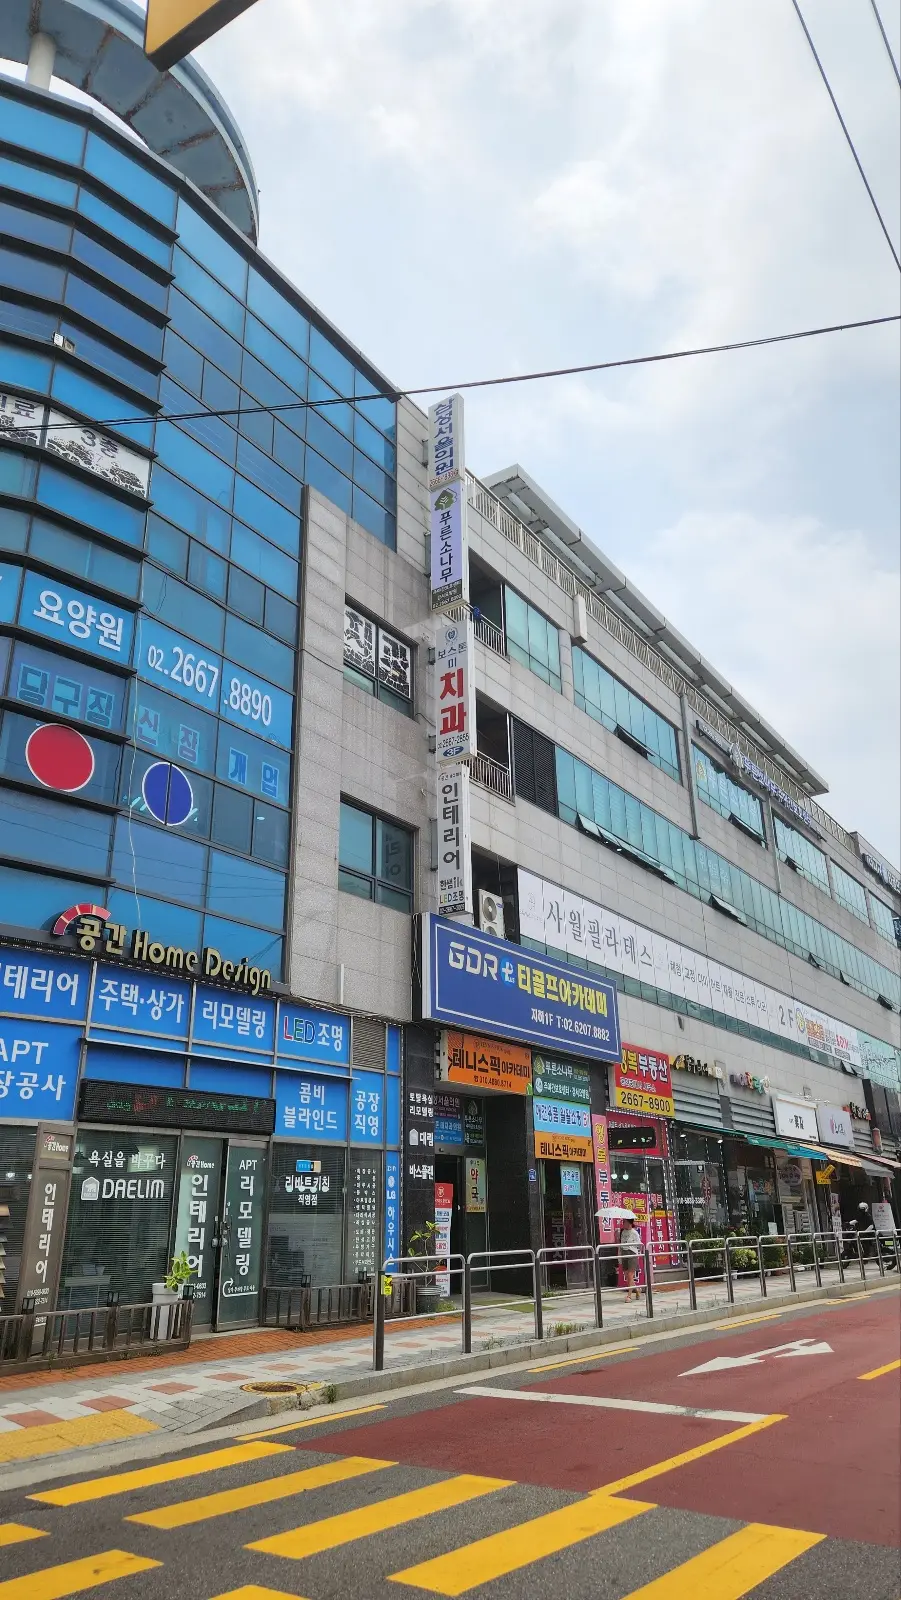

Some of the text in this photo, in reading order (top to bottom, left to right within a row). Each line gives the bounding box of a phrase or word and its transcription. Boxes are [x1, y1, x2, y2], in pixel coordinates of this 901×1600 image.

[434, 397, 455, 476] 삼성서울의원
[439, 511, 454, 583] 푸른소나무
[33, 590, 123, 651] 요양원
[438, 640, 467, 660] 보스톤
[18, 664, 114, 727] 당구장
[439, 667, 467, 737] 치과
[447, 746, 461, 757] 3F
[442, 783, 459, 870] 인테리어
[547, 901, 652, 966] 사월필라테스
[77, 918, 272, 996] 공간 Home Design
[0, 963, 79, 1006] 테리어
[449, 942, 498, 981] GDR
[517, 963, 608, 1018] 티골프아카데미
[202, 1000, 266, 1039] 리모델링
[531, 1008, 553, 1026] 지하1F
[283, 1015, 344, 1052] LED조명
[545, 1061, 573, 1079] 푸른소나무
[298, 1082, 325, 1106] 콤비
[355, 1090, 380, 1112] 공장
[410, 1092, 434, 1105] 토탈욕실
[620, 1091, 671, 1112] 2667-8900
[283, 1105, 337, 1131] 블라인드
[355, 1114, 379, 1137] 직영
[410, 1105, 434, 1118] 리모델링
[419, 1131, 434, 1147] 대림
[88, 1150, 166, 1170] 욕실을 바꾸다
[239, 1160, 258, 1171] APT
[102, 1178, 165, 1199] DAELIM
[298, 1194, 318, 1206] 직영점
[387, 1190, 396, 1200] LG
[470, 1168, 480, 1203] 약국
[36, 1182, 57, 1284] 인테리어
[187, 1173, 208, 1278] 인테리어
[235, 1175, 254, 1277] 리모델링
[387, 1206, 396, 1266] 하우시스
